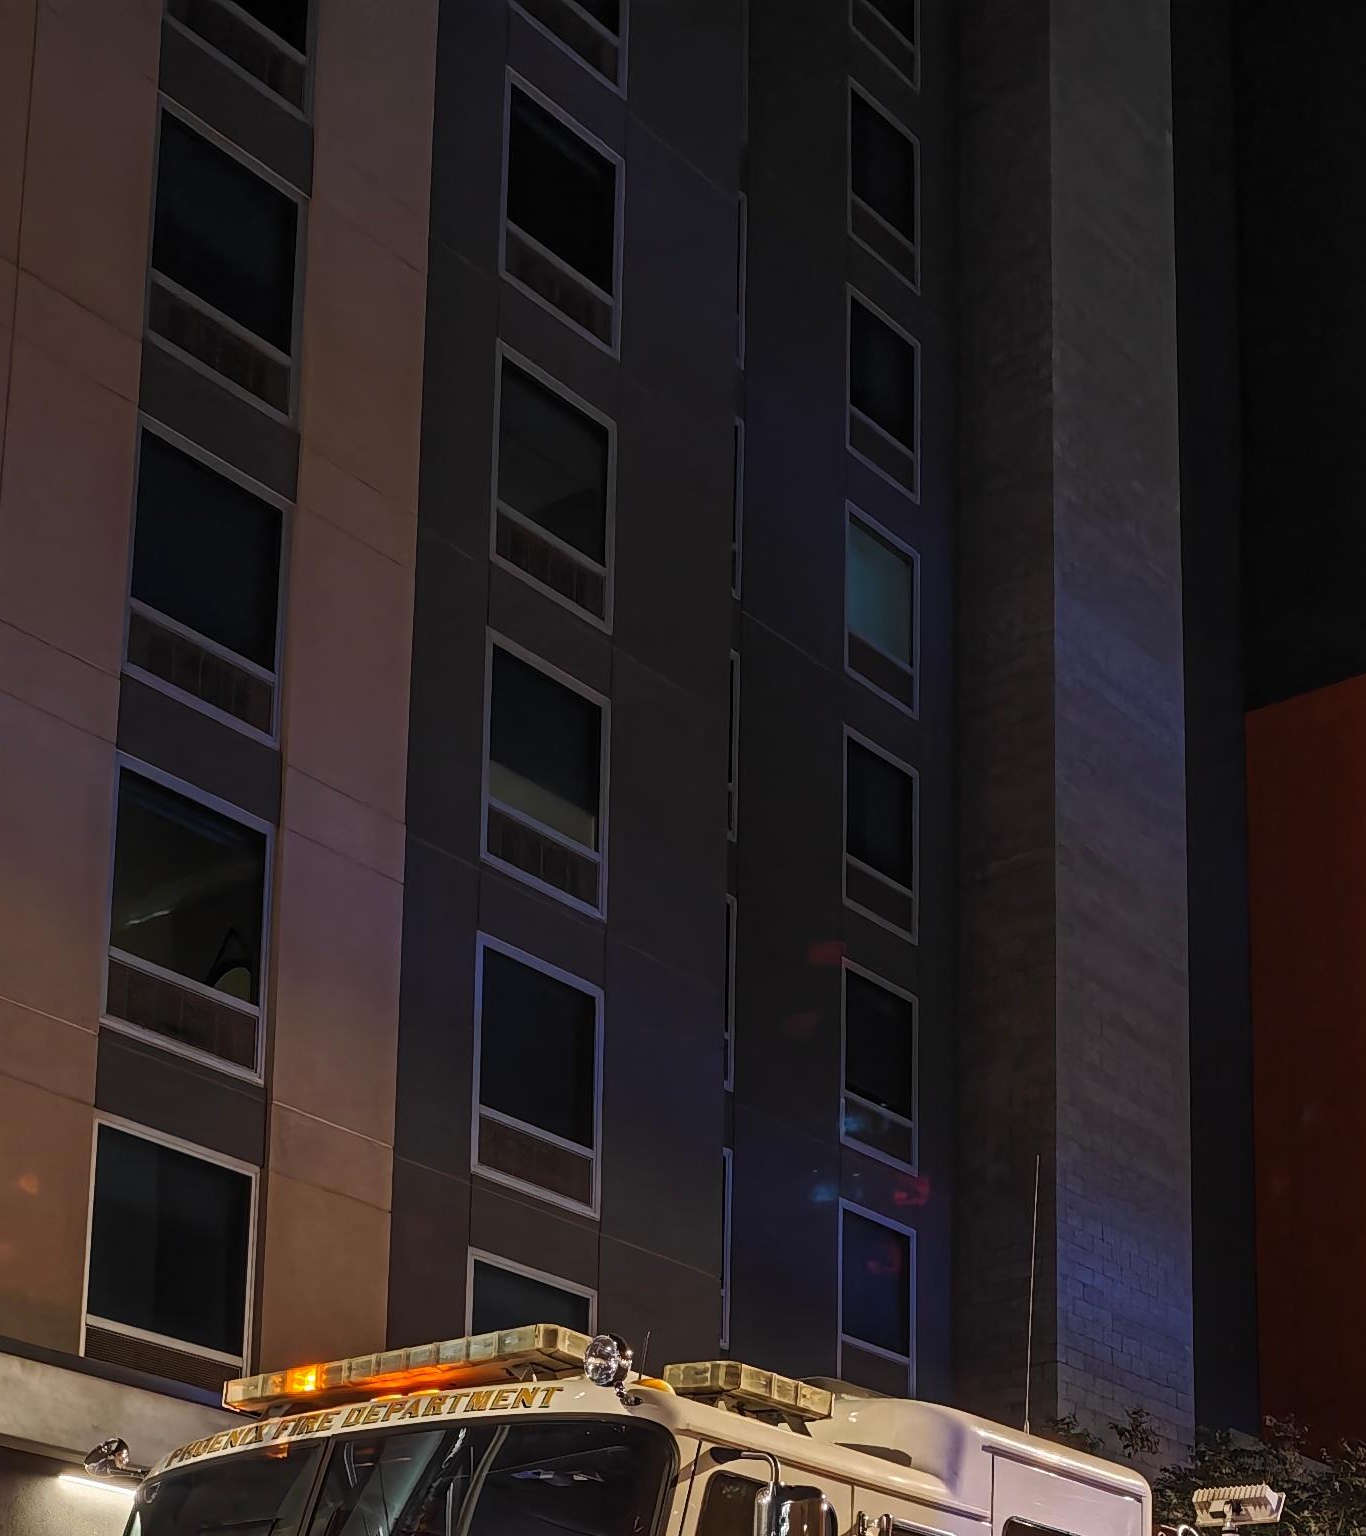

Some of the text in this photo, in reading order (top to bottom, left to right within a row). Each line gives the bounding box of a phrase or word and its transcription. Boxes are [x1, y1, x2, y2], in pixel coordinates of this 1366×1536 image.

[165, 1386, 565, 1469] PHOENIX FIRE DEPARTMENT
